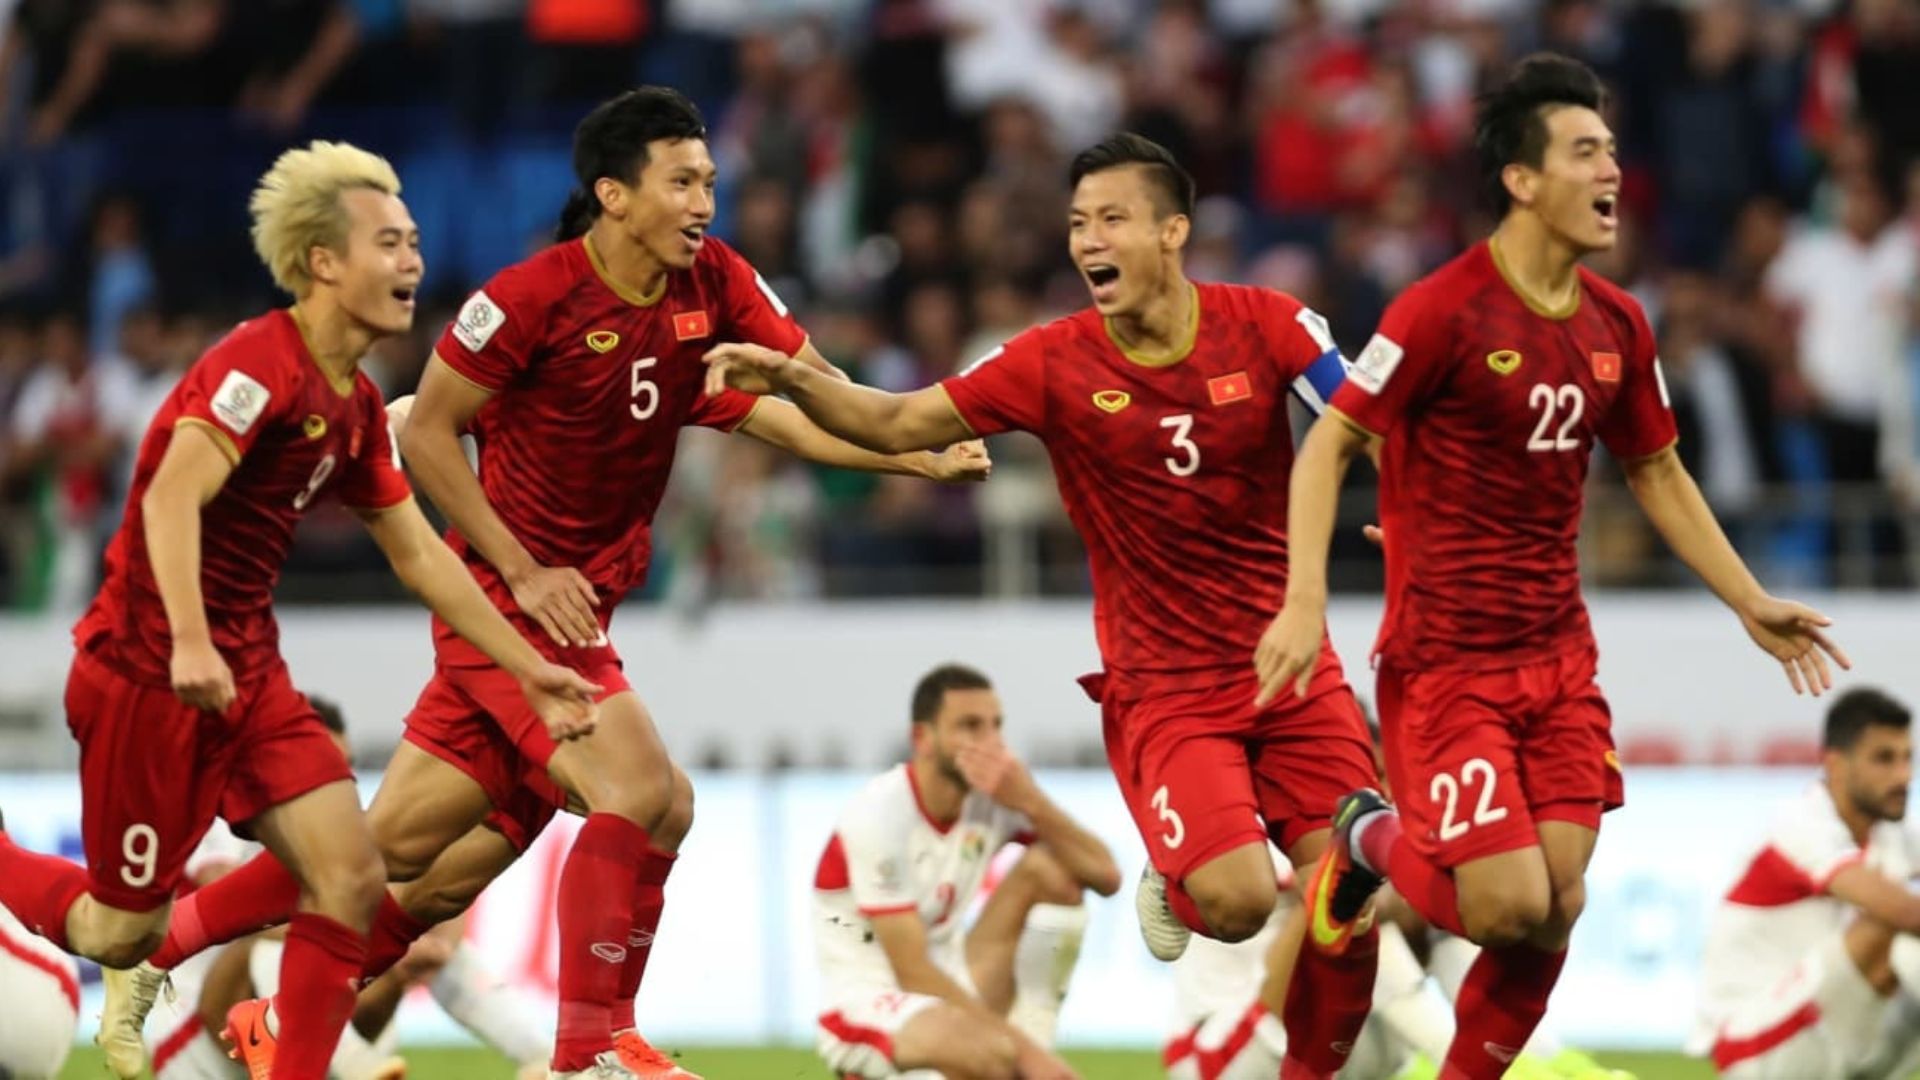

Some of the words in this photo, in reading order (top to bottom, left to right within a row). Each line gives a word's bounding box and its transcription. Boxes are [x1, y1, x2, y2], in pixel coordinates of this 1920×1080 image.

[630, 357, 659, 420] 5
[1527, 383, 1585, 451] 22
[1159, 414, 1200, 477] 3
[293, 453, 335, 510] 9
[1150, 784, 1186, 850] 3
[1429, 757, 1509, 842] 22
[120, 823, 159, 887] 9
